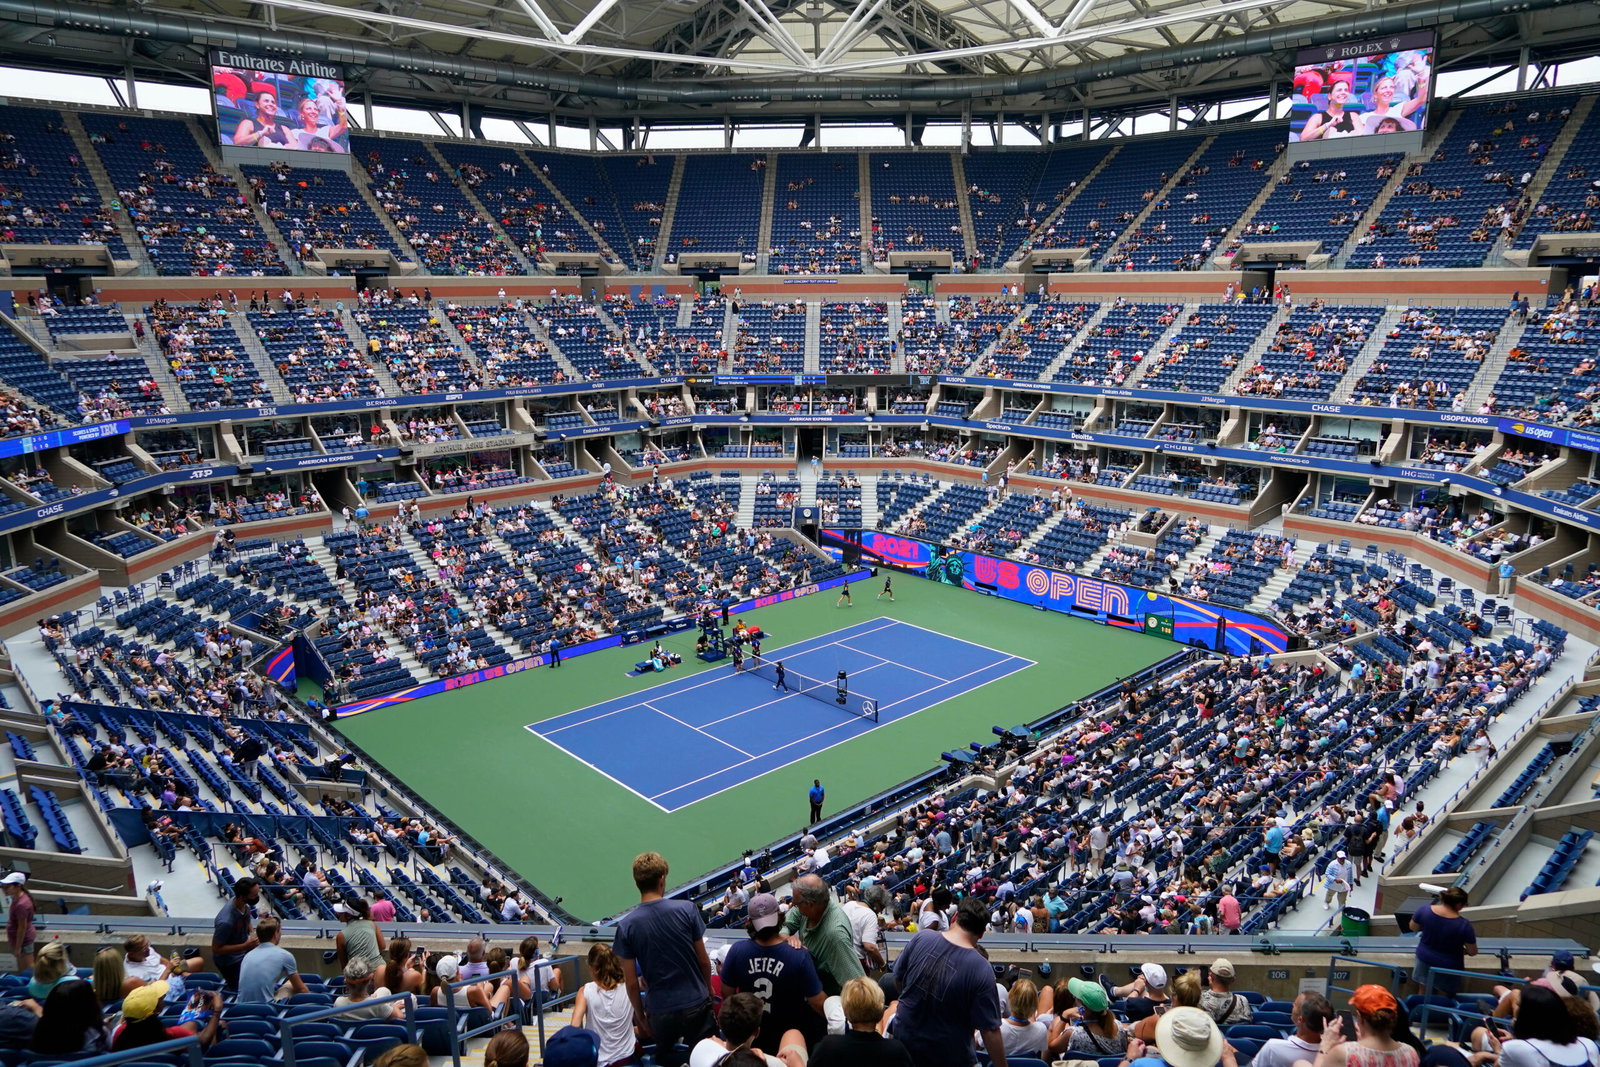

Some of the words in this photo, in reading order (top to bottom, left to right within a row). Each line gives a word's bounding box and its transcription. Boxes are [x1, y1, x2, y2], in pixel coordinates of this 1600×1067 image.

[1341, 42, 1383, 56] ROLEX
[219, 51, 285, 73] Emirates
[289, 61, 337, 78] Airline
[366, 399, 397, 407] BERMUDA
[1311, 404, 1341, 413] CHASE
[258, 407, 277, 417] IBM
[1440, 414, 1489, 424] USOPEN.ORG
[100, 422, 118, 436] IBM
[986, 422, 1009, 431] Spectrum
[1525, 426, 1534, 434] us
[1534, 427, 1553, 439] open
[1164, 443, 1194, 451] CHUBB
[298, 457, 328, 466] AMERICAN
[329, 455, 354, 463] EXPRESS
[1401, 469, 1417, 478] IHG
[37, 503, 64, 518] CHASE
[1553, 505, 1573, 519] Emirates
[1573, 512, 1589, 523] Airline
[873, 534, 919, 559] 2021
[974, 555, 1020, 589] US
[1026, 568, 1129, 616] OPEN
[755, 594, 778, 608] 2021
[781, 590, 793, 600] US
[794, 584, 819, 598] OPEN
[445, 672, 480, 691] 2021
[484, 666, 504, 680] US
[505, 656, 544, 674] OPEN
[748, 957, 784, 977] JETER
[1271, 971, 1286, 979] 106
[1333, 970, 1347, 979] 107
[753, 977, 773, 1014] 2
